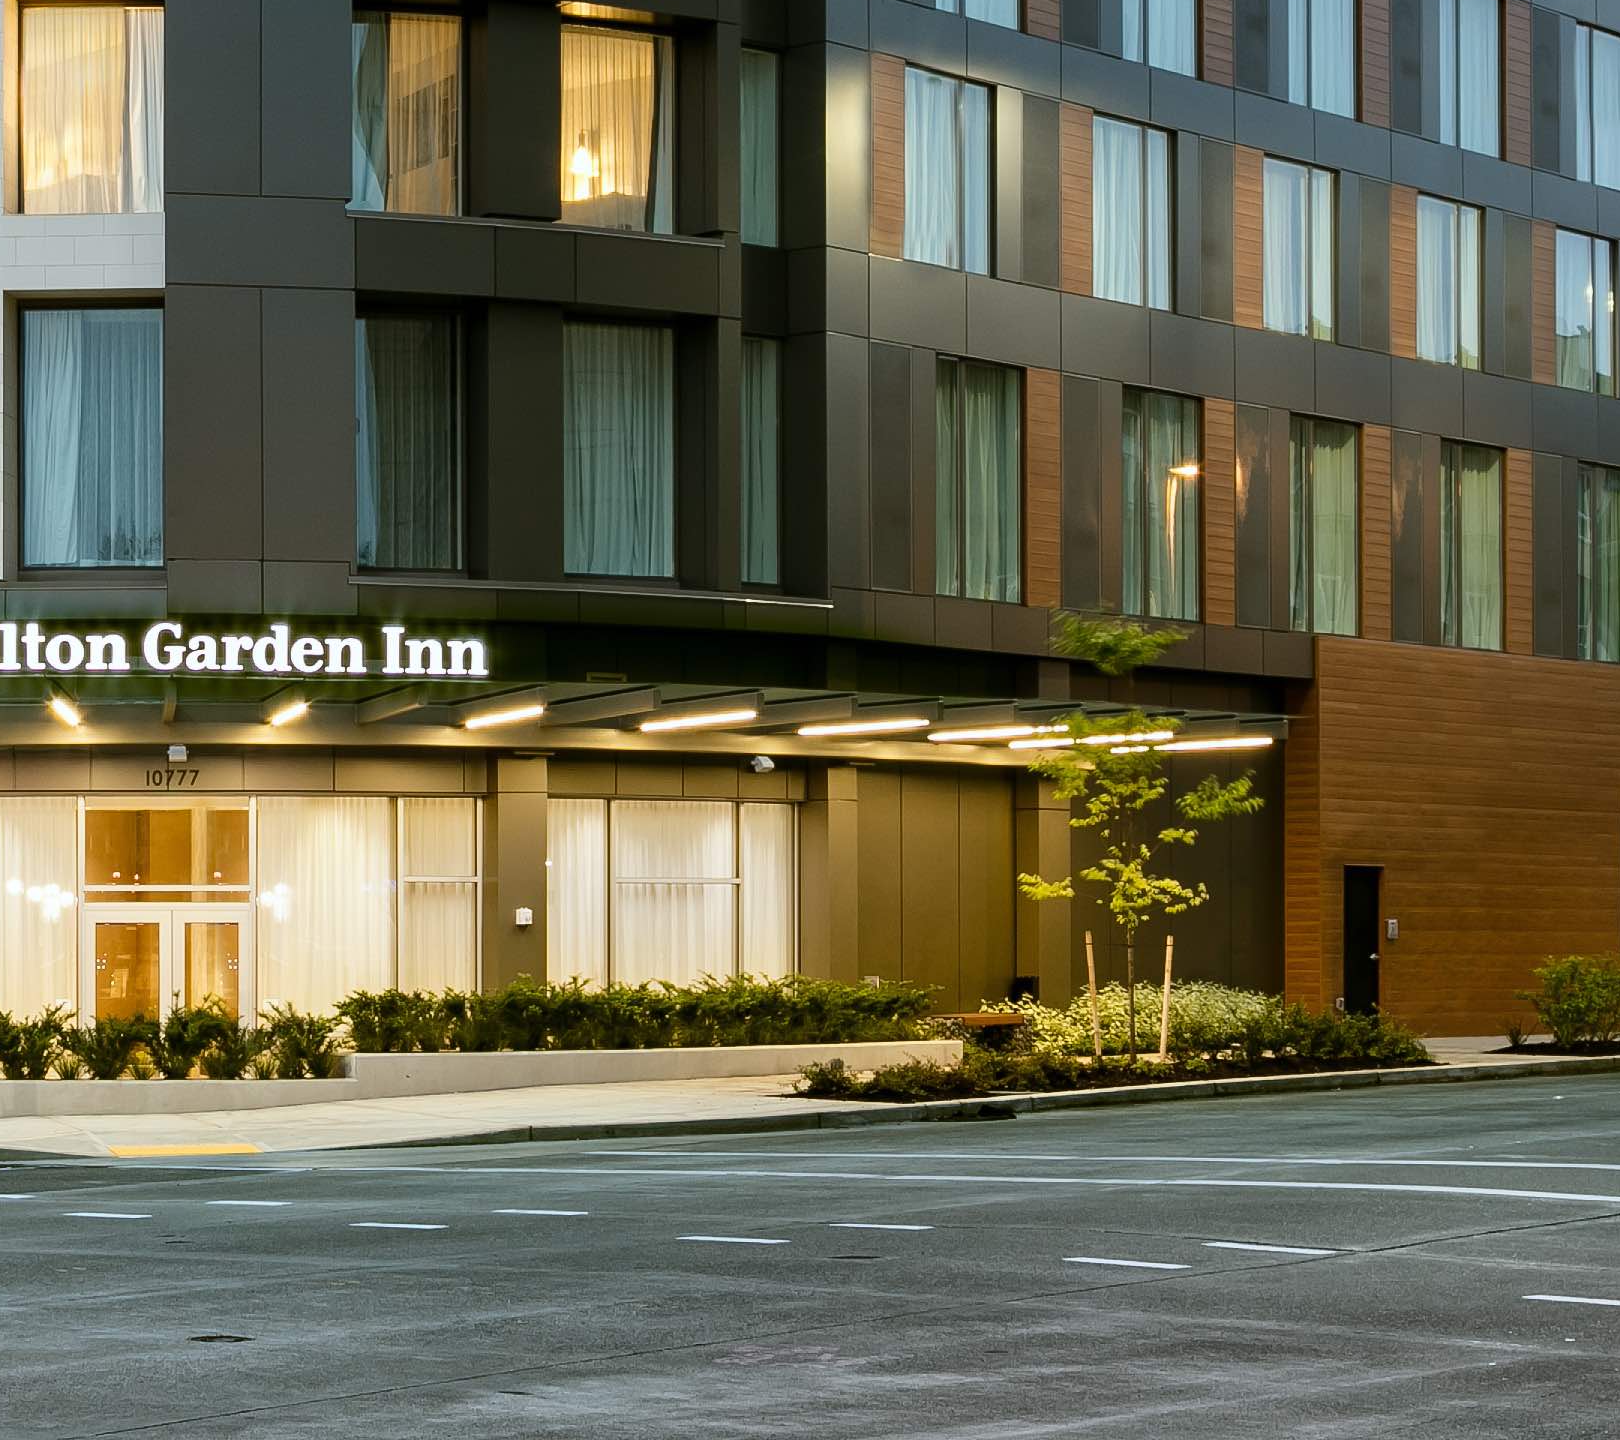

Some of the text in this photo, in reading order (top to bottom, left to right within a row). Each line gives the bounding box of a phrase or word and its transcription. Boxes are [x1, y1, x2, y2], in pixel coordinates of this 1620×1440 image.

[143, 622, 367, 674] Garden
[381, 626, 489, 676] Inn
[146, 769, 200, 787] 10777
